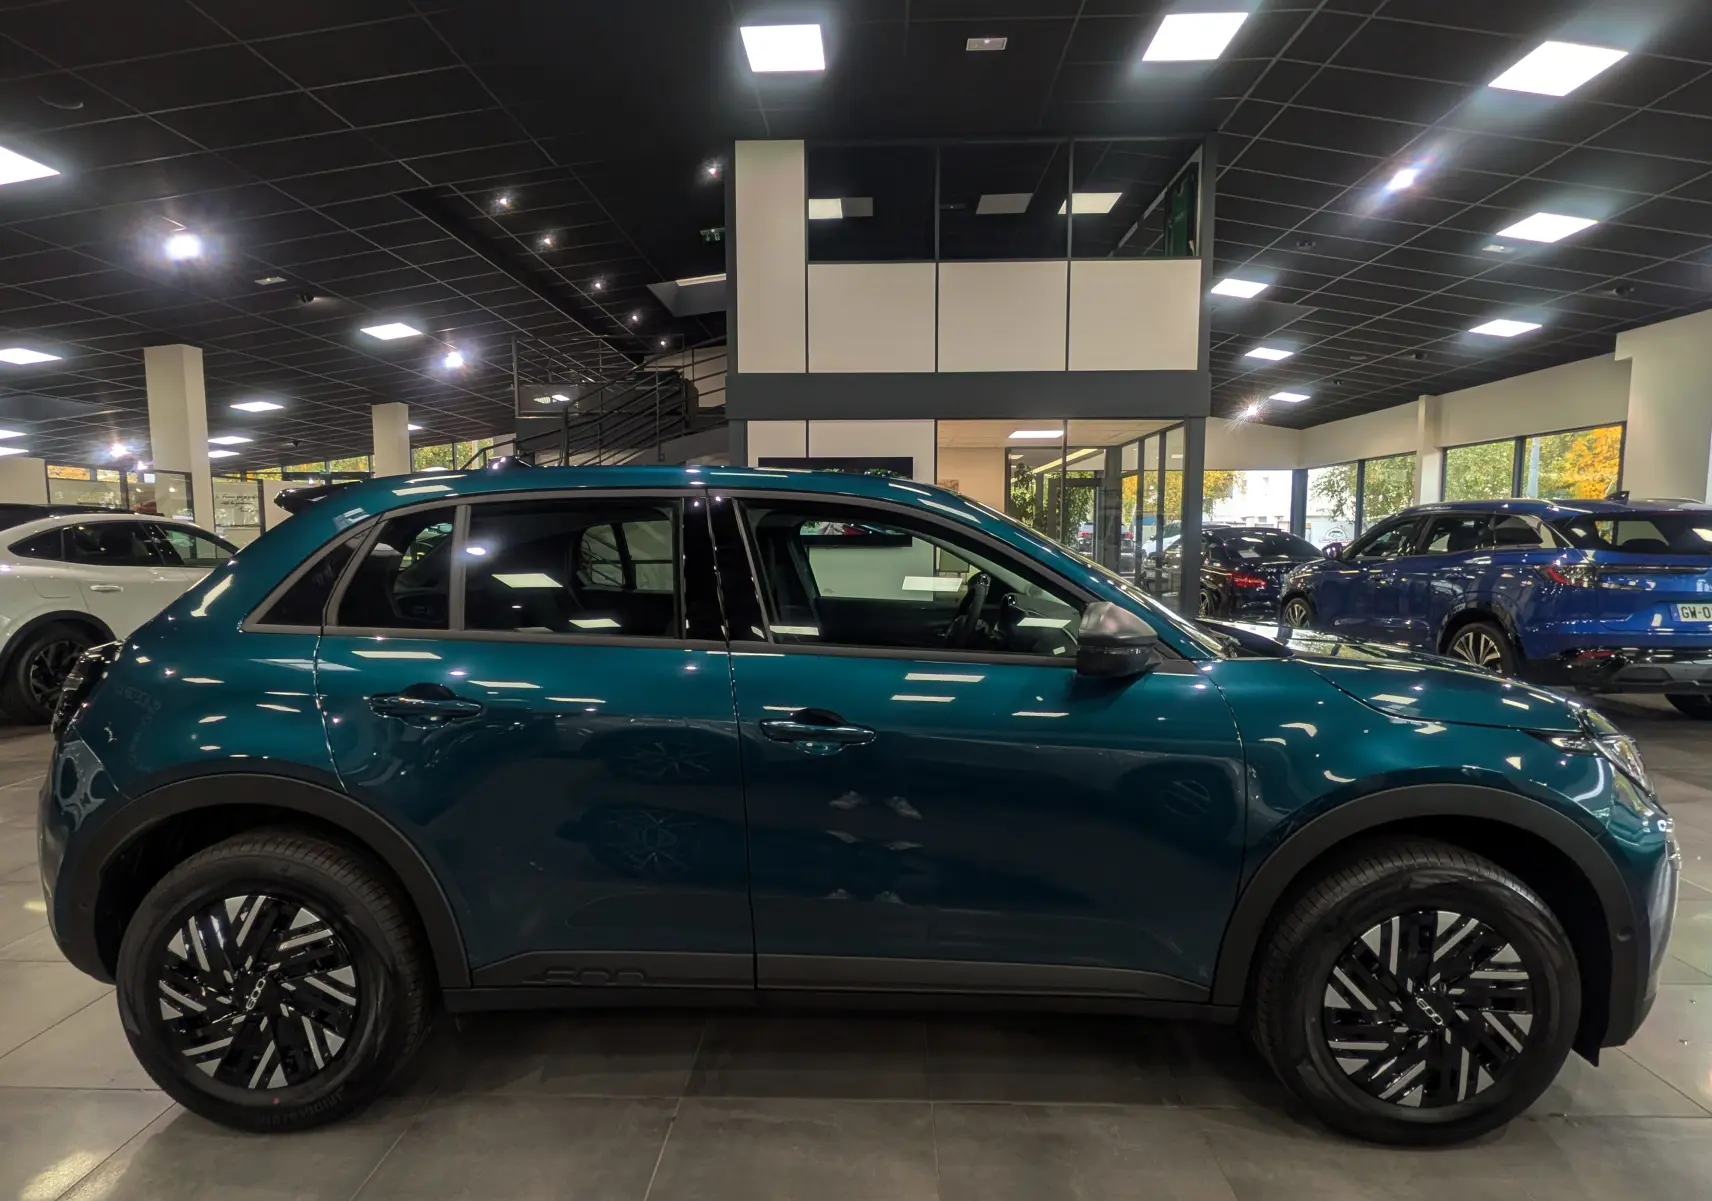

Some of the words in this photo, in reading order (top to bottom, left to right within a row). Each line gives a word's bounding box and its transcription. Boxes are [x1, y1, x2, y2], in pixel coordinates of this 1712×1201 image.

[1681, 606, 1712, 619] GW-0
[246, 979, 266, 1010] 600
[1416, 998, 1444, 1025] 600
